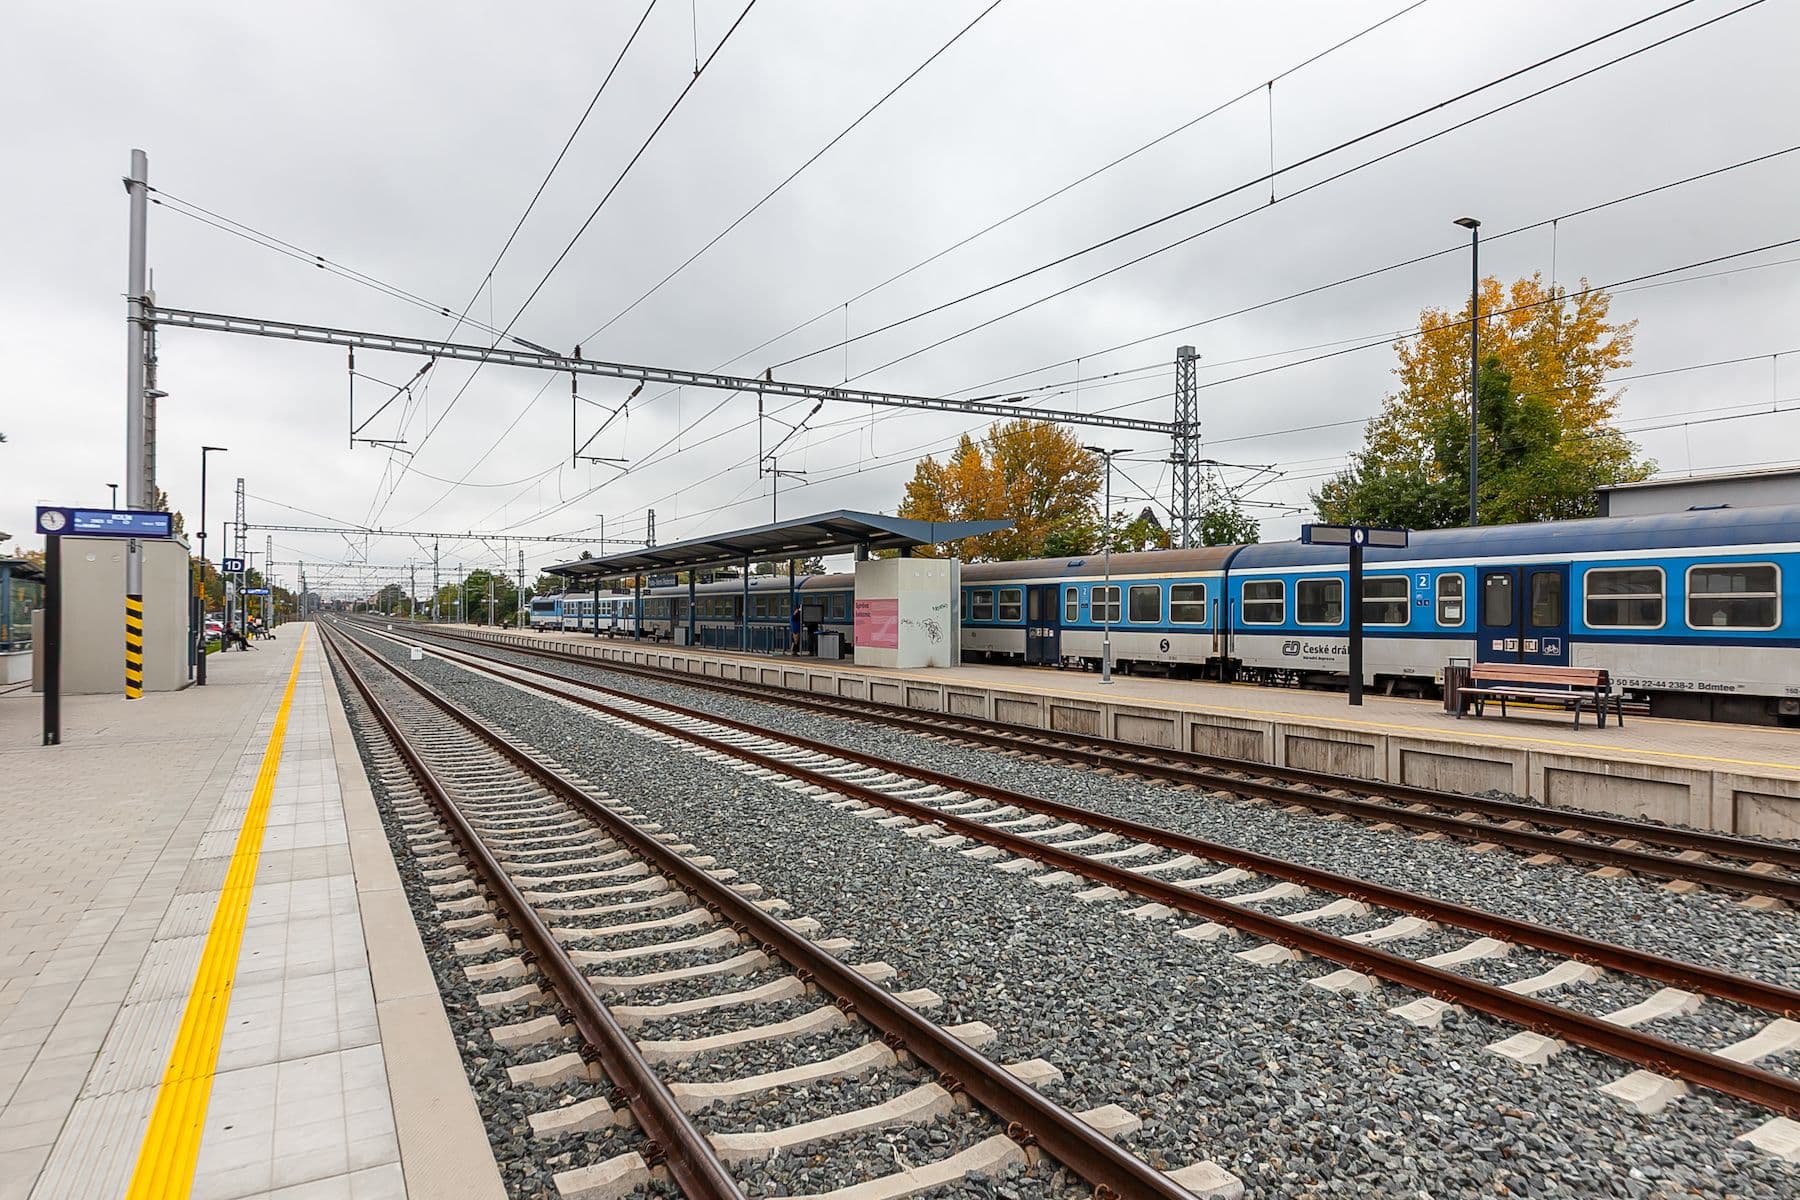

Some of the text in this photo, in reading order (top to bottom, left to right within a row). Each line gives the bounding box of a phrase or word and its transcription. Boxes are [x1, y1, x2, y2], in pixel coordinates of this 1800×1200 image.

[225, 561, 242, 570] 1D
[1419, 576, 1427, 586] 2
[1161, 640, 1169, 652] S
[1303, 642, 1350, 655] České drá
[1617, 678, 1628, 687] 50
[1629, 679, 1640, 687] 54
[1642, 680, 1666, 688] 22-44
[1668, 681, 1694, 690] 238-2
[1698, 682, 1735, 692] Bdmtee
